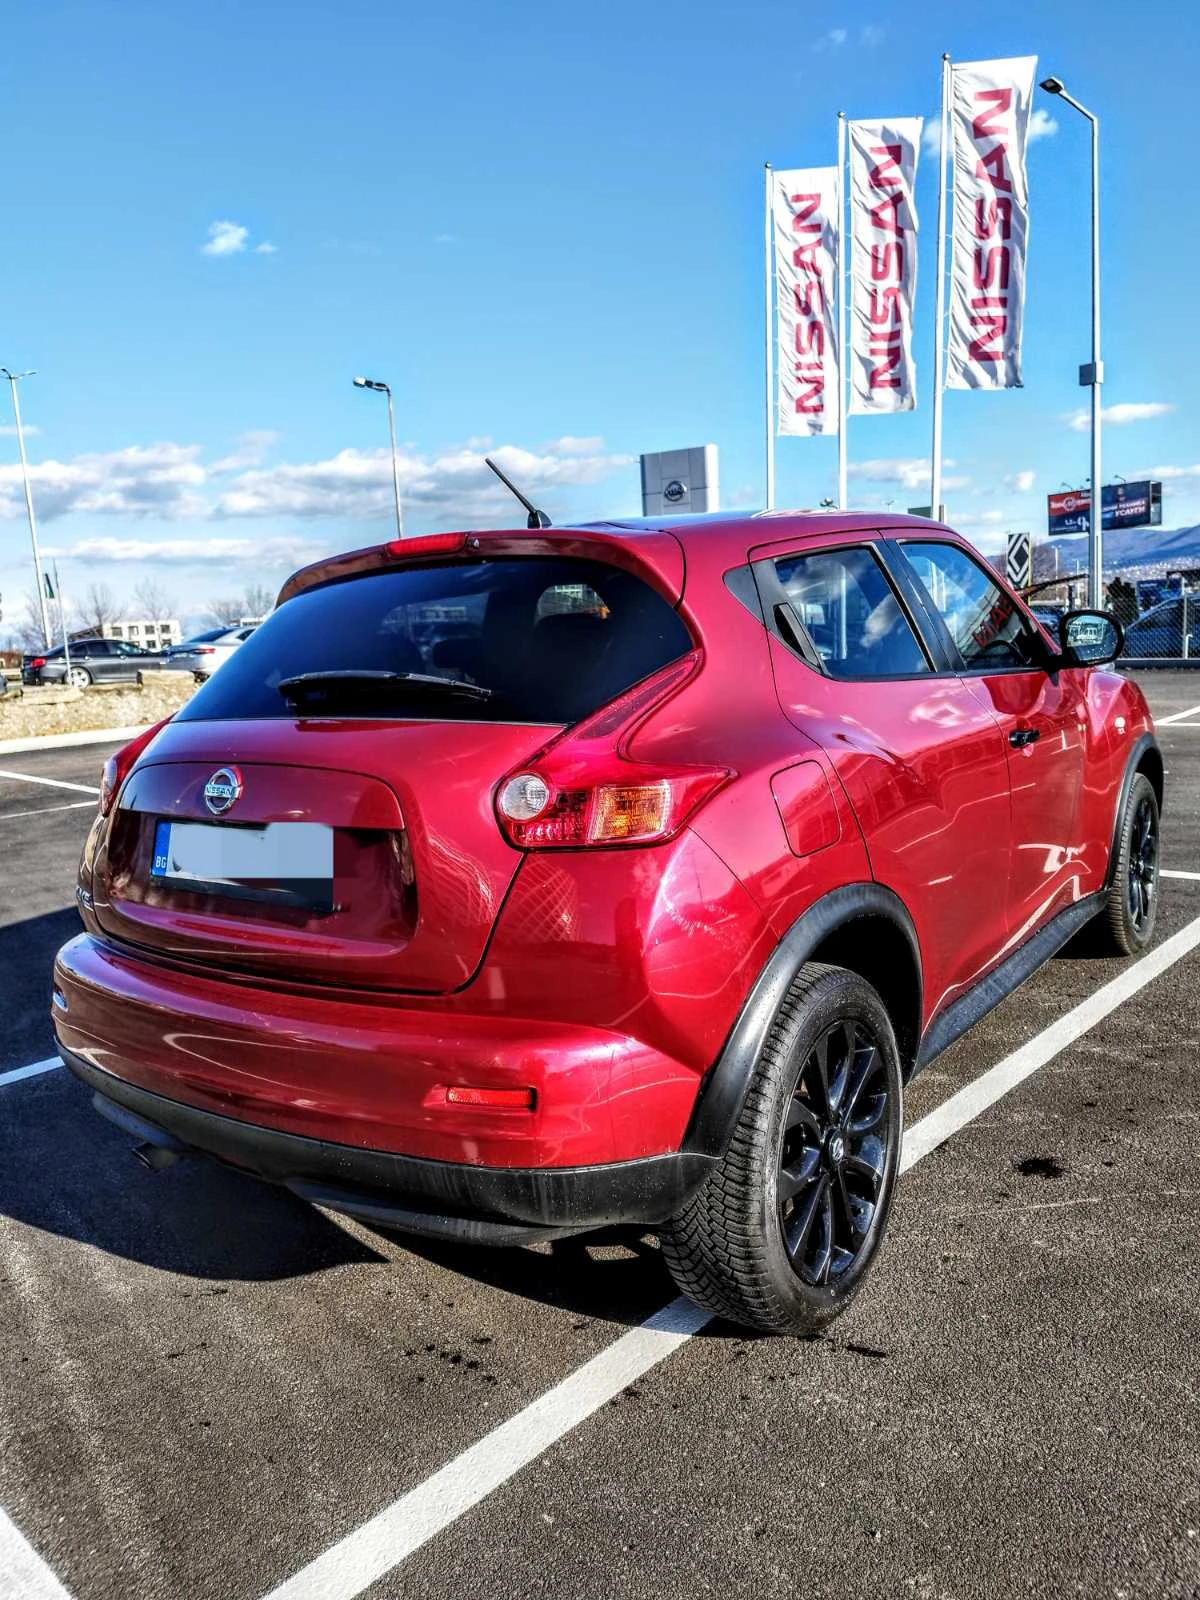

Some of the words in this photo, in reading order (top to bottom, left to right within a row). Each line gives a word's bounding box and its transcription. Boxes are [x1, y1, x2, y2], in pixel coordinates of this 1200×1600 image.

[791, 193, 825, 414] NISSAN
[868, 145, 904, 388] NISSAN
[969, 88, 1012, 361] NISSAN
[155, 855, 168, 869] BG
[206, 785, 233, 796] NISSAN
